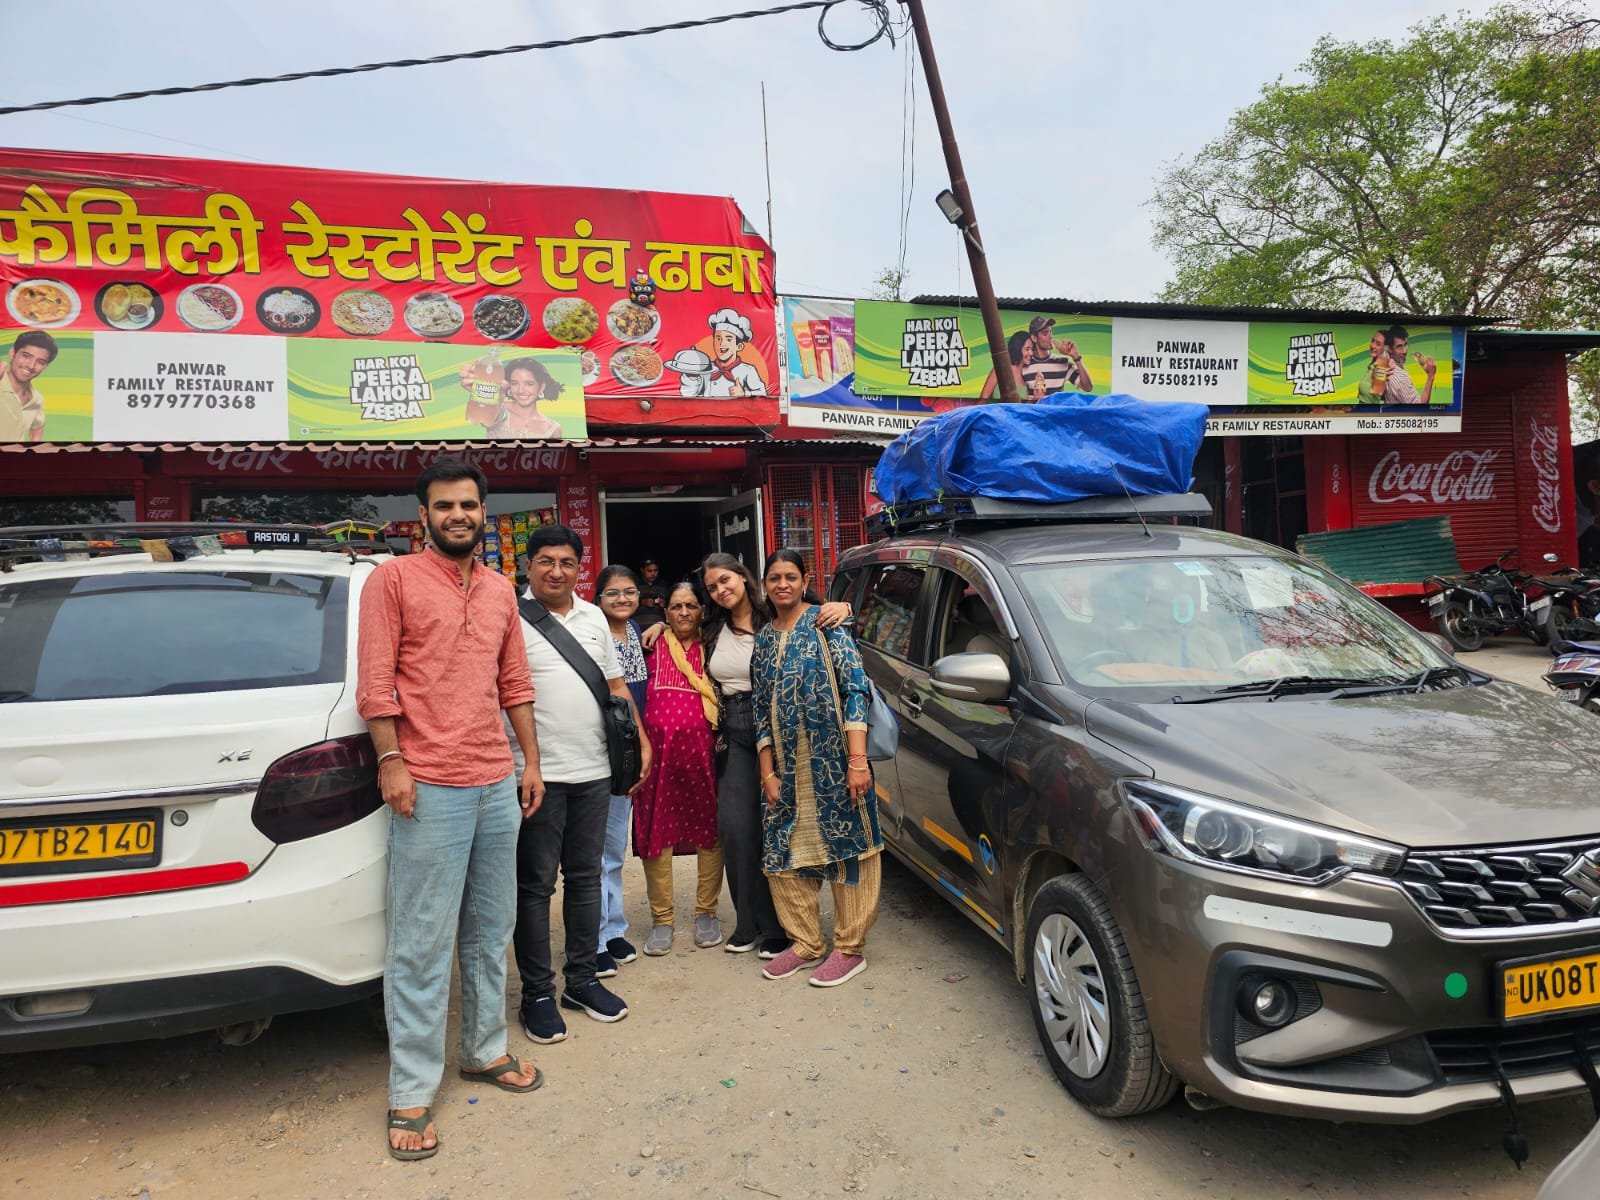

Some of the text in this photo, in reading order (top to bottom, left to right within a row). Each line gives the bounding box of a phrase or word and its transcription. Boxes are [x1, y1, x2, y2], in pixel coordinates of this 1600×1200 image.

[0, 184, 264, 275] फैमिली
[282, 200, 524, 287] रेस्टोरेंट
[645, 241, 765, 294] ढाबा
[907, 317, 958, 333] HAR KOI
[903, 330, 965, 351] PEERA
[1157, 341, 1205, 355] PANWAR
[1291, 333, 1334, 349] HAR KOI
[355, 355, 417, 371] HAR KOI
[901, 348, 968, 368] LAHORI
[1122, 355, 1239, 371] FAMILY RESTAURANT
[1288, 347, 1337, 363] PEERA
[157, 363, 226, 376] PANWAR
[1286, 359, 1341, 379] LAHORI
[107, 378, 274, 393] FAMILY RESTAURANT
[351, 367, 425, 388] PEERA
[909, 367, 961, 388] ZEERA
[1142, 373, 1219, 386] 8755082195
[350, 383, 432, 404] LAHORI
[1293, 377, 1335, 396] ZEERA
[127, 394, 256, 409] 8979770368
[361, 401, 424, 421] ZEERA
[822, 412, 919, 430] PANWAR FAMILY
[1223, 420, 1260, 432] FAMILY
[1263, 419, 1331, 431] RESTAURANT
[1357, 418, 1439, 429] Mob.: 8755082195
[217, 748, 254, 764] XE
[1519, 962, 1598, 1004] UK08T
